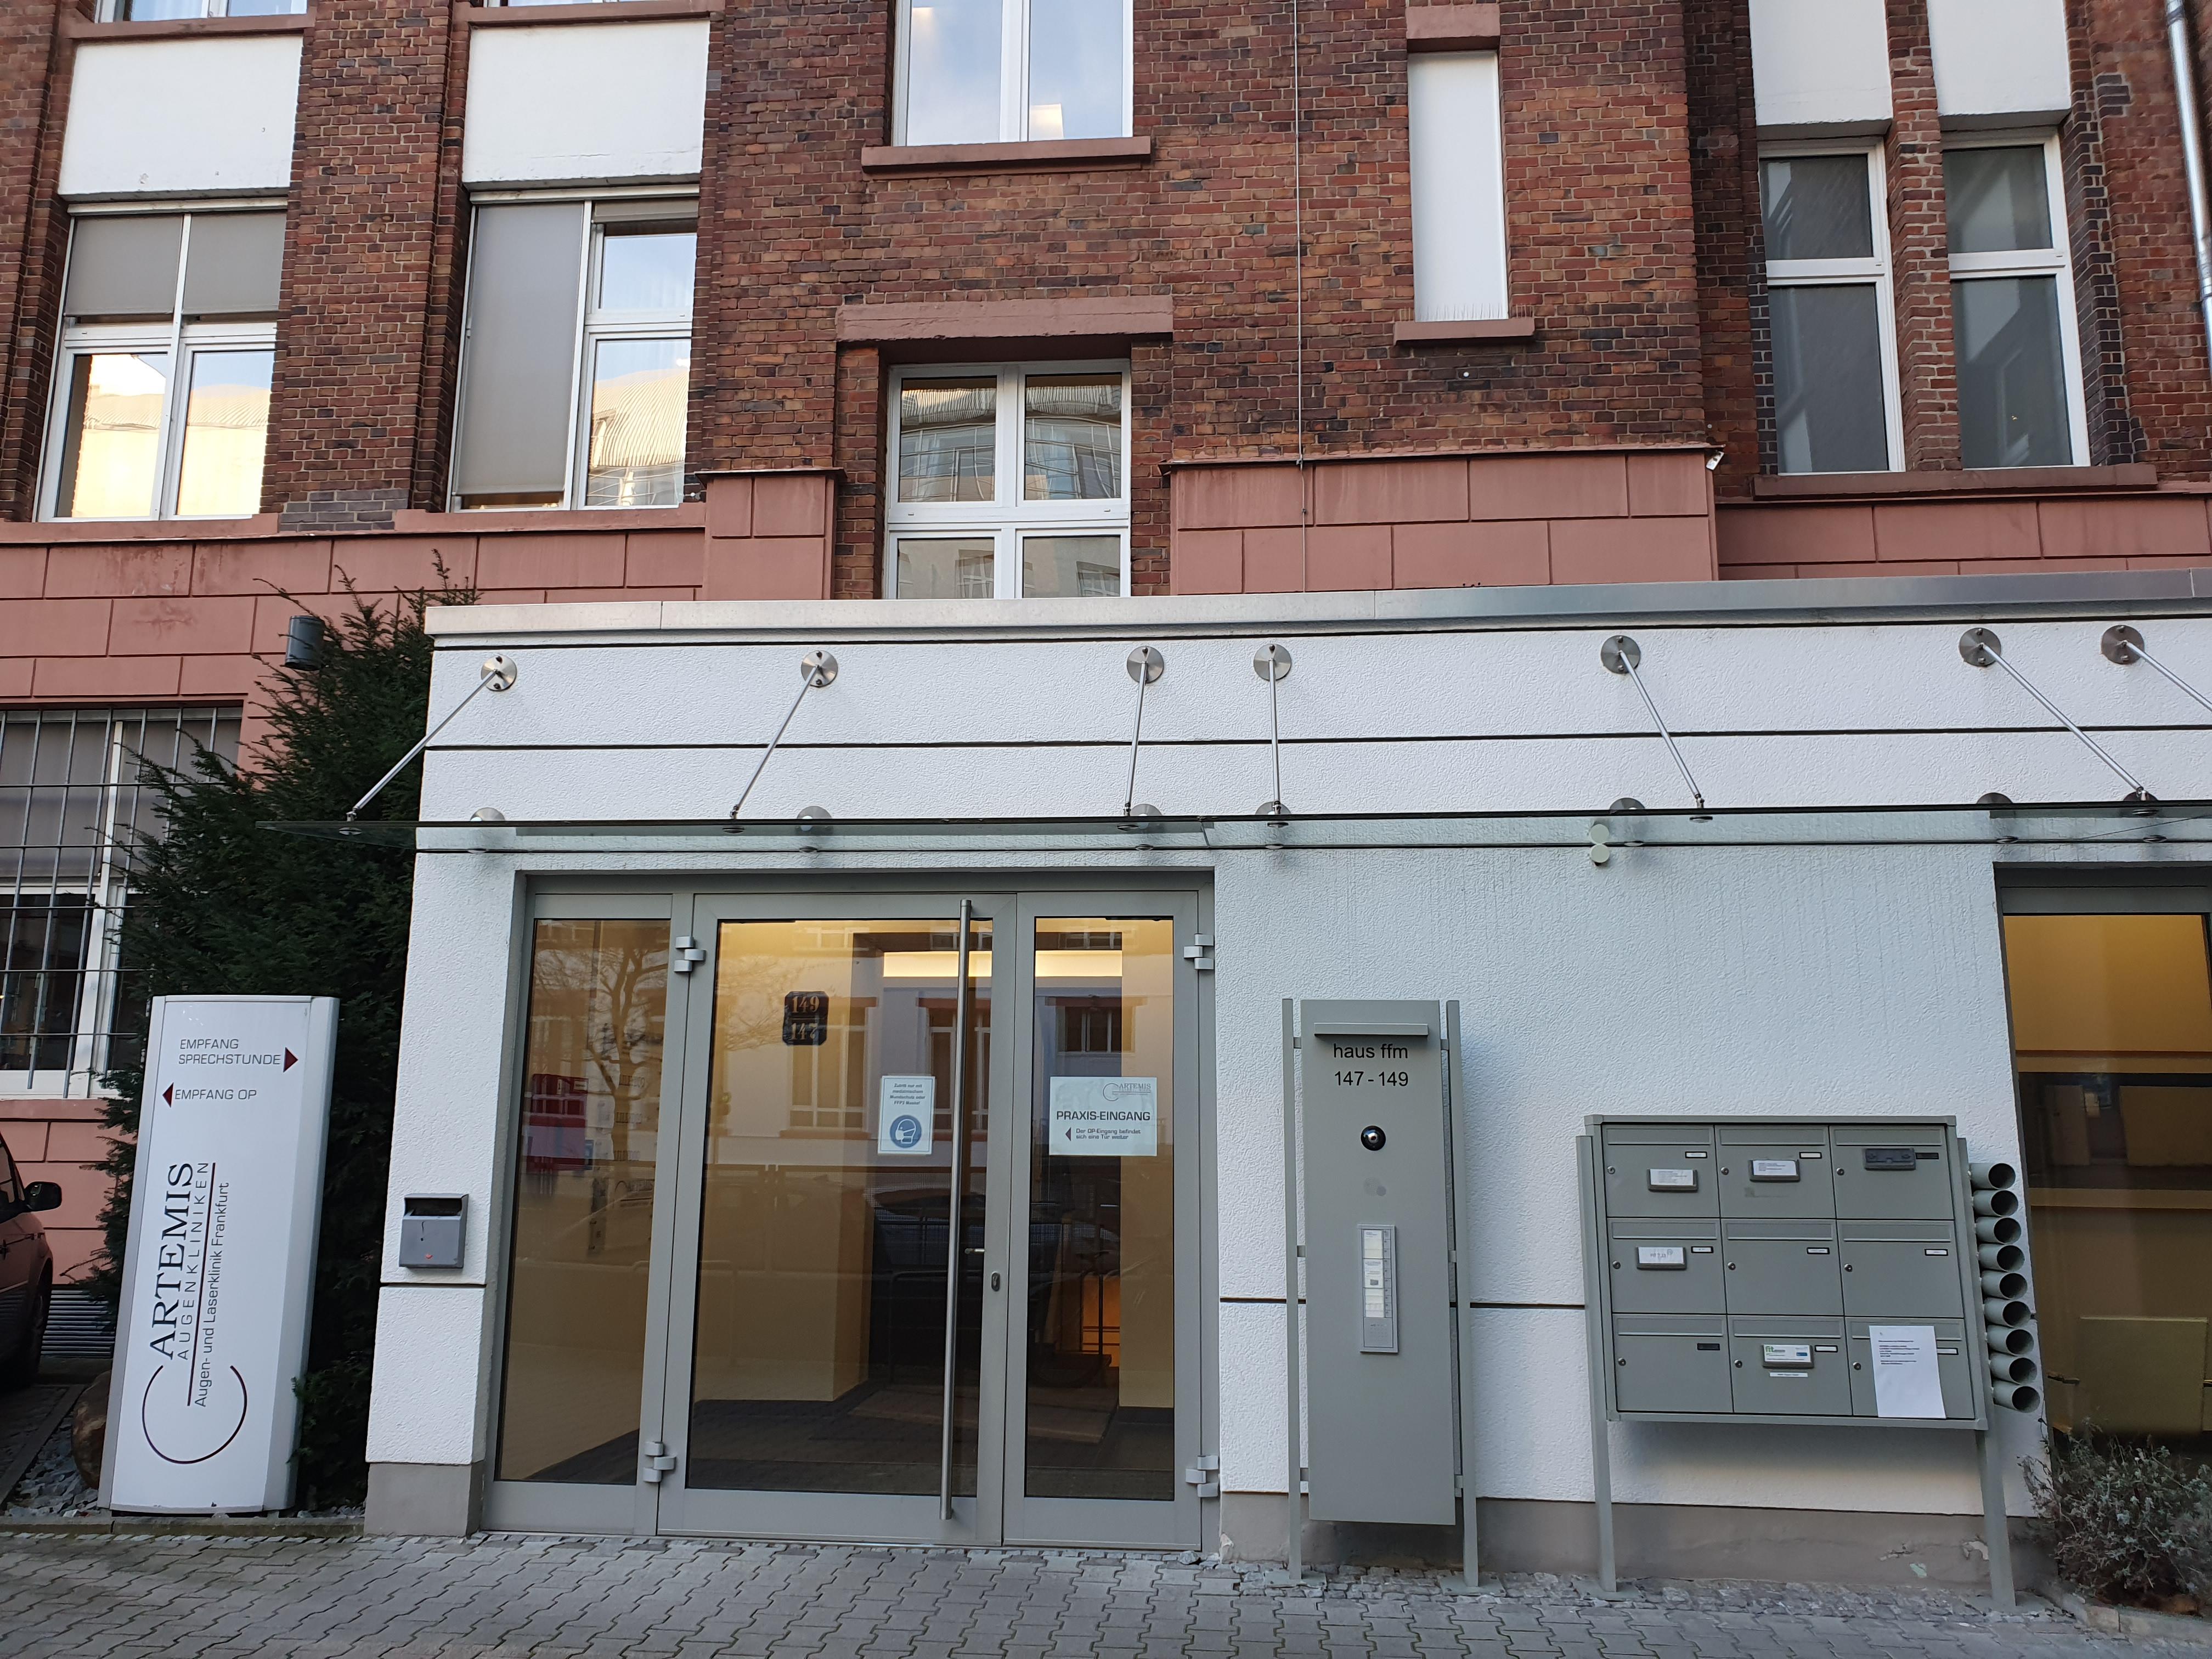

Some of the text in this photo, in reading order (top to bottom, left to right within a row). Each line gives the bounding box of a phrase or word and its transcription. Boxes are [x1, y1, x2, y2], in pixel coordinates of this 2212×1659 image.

[792, 996, 820, 1013] 149
[791, 1023, 818, 1040] 147
[180, 1039, 239, 1049] EMPFANG
[1334, 1043, 1408, 1058] haus ffm
[178, 1054, 281, 1064] SPRECHSTUNDE
[1335, 1071, 1364, 1086] 147
[1379, 1071, 1408, 1086] 149
[175, 1090, 257, 1099] EMPFANG OP
[1057, 1111, 1150, 1121] PRAXIS-EINGANG
[150, 1163, 193, 1360] ARTEMIS
[177, 1163, 208, 1360] AUGENKLINIKEN
[195, 1182, 229, 1407] Augen- und Laserklinik Frankfurt
